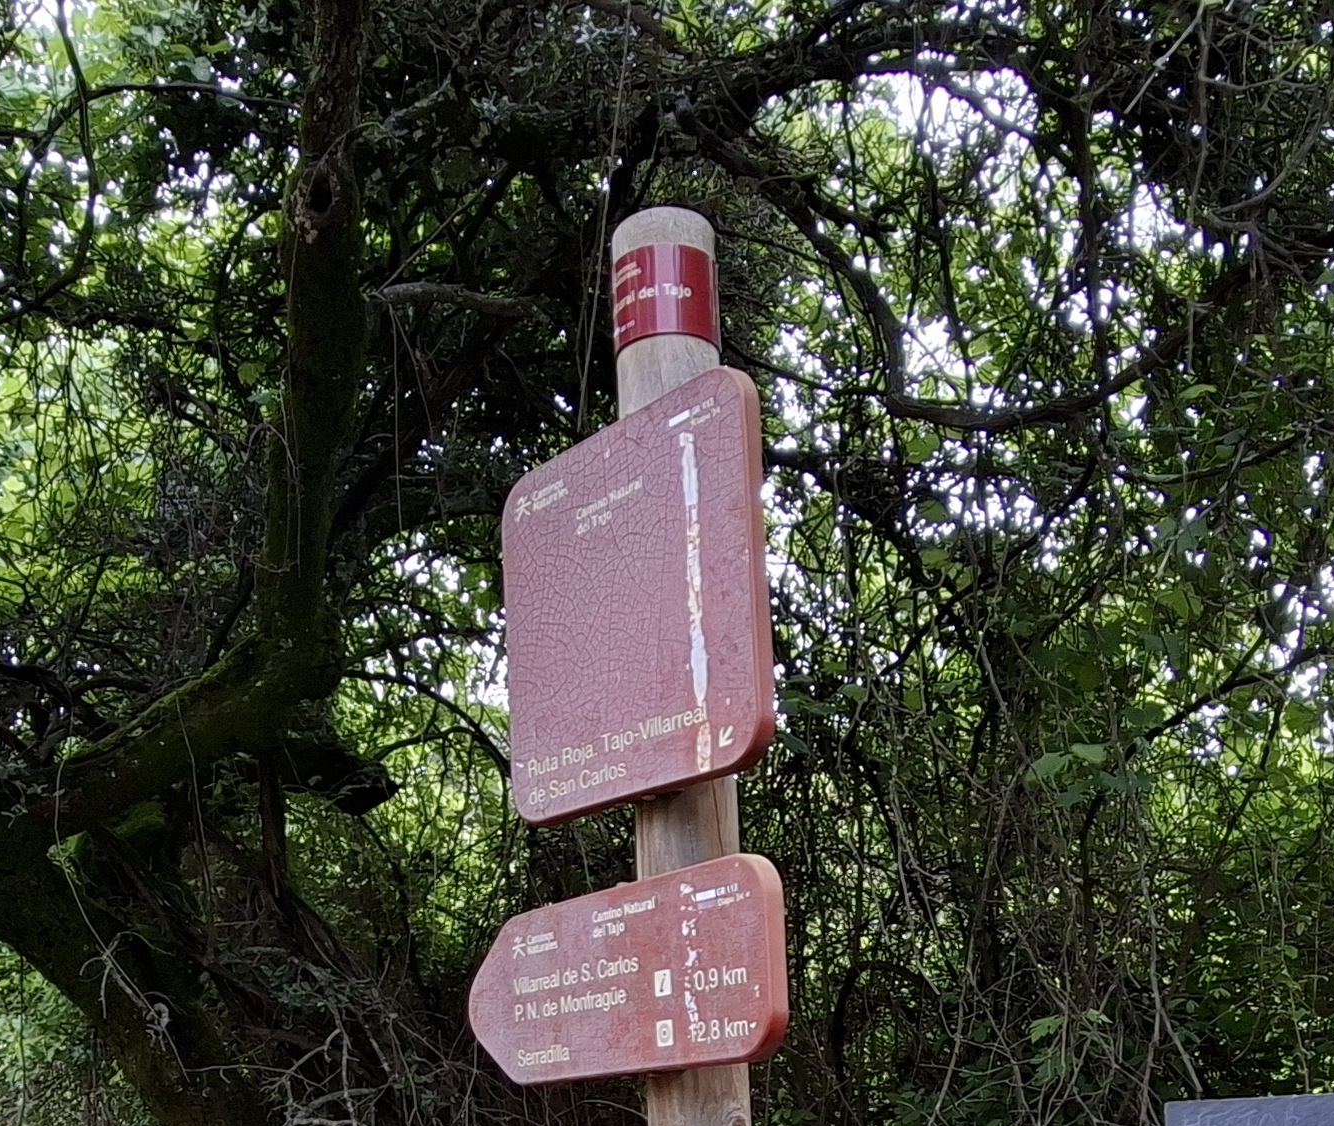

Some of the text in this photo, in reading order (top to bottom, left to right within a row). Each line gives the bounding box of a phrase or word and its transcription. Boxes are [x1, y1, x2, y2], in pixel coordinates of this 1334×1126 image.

[639, 283, 659, 300] del
[663, 283, 692, 300] Tajo
[576, 476, 643, 520] Camino Natural
[591, 510, 613, 528] Tajo
[528, 704, 707, 779] Ruta Roja. Tajo-Villarreal
[528, 761, 627, 805] de San Carlos
[592, 895, 657, 923] Camino Natural
[592, 921, 625, 939] del Tajo
[513, 956, 748, 996] Villarreal de S. Carlos 0,9 km
[543, 997, 558, 1017] de
[560, 987, 627, 1015] Monfragüe
[517, 1016, 750, 1067] Serradilla 12,8 km
